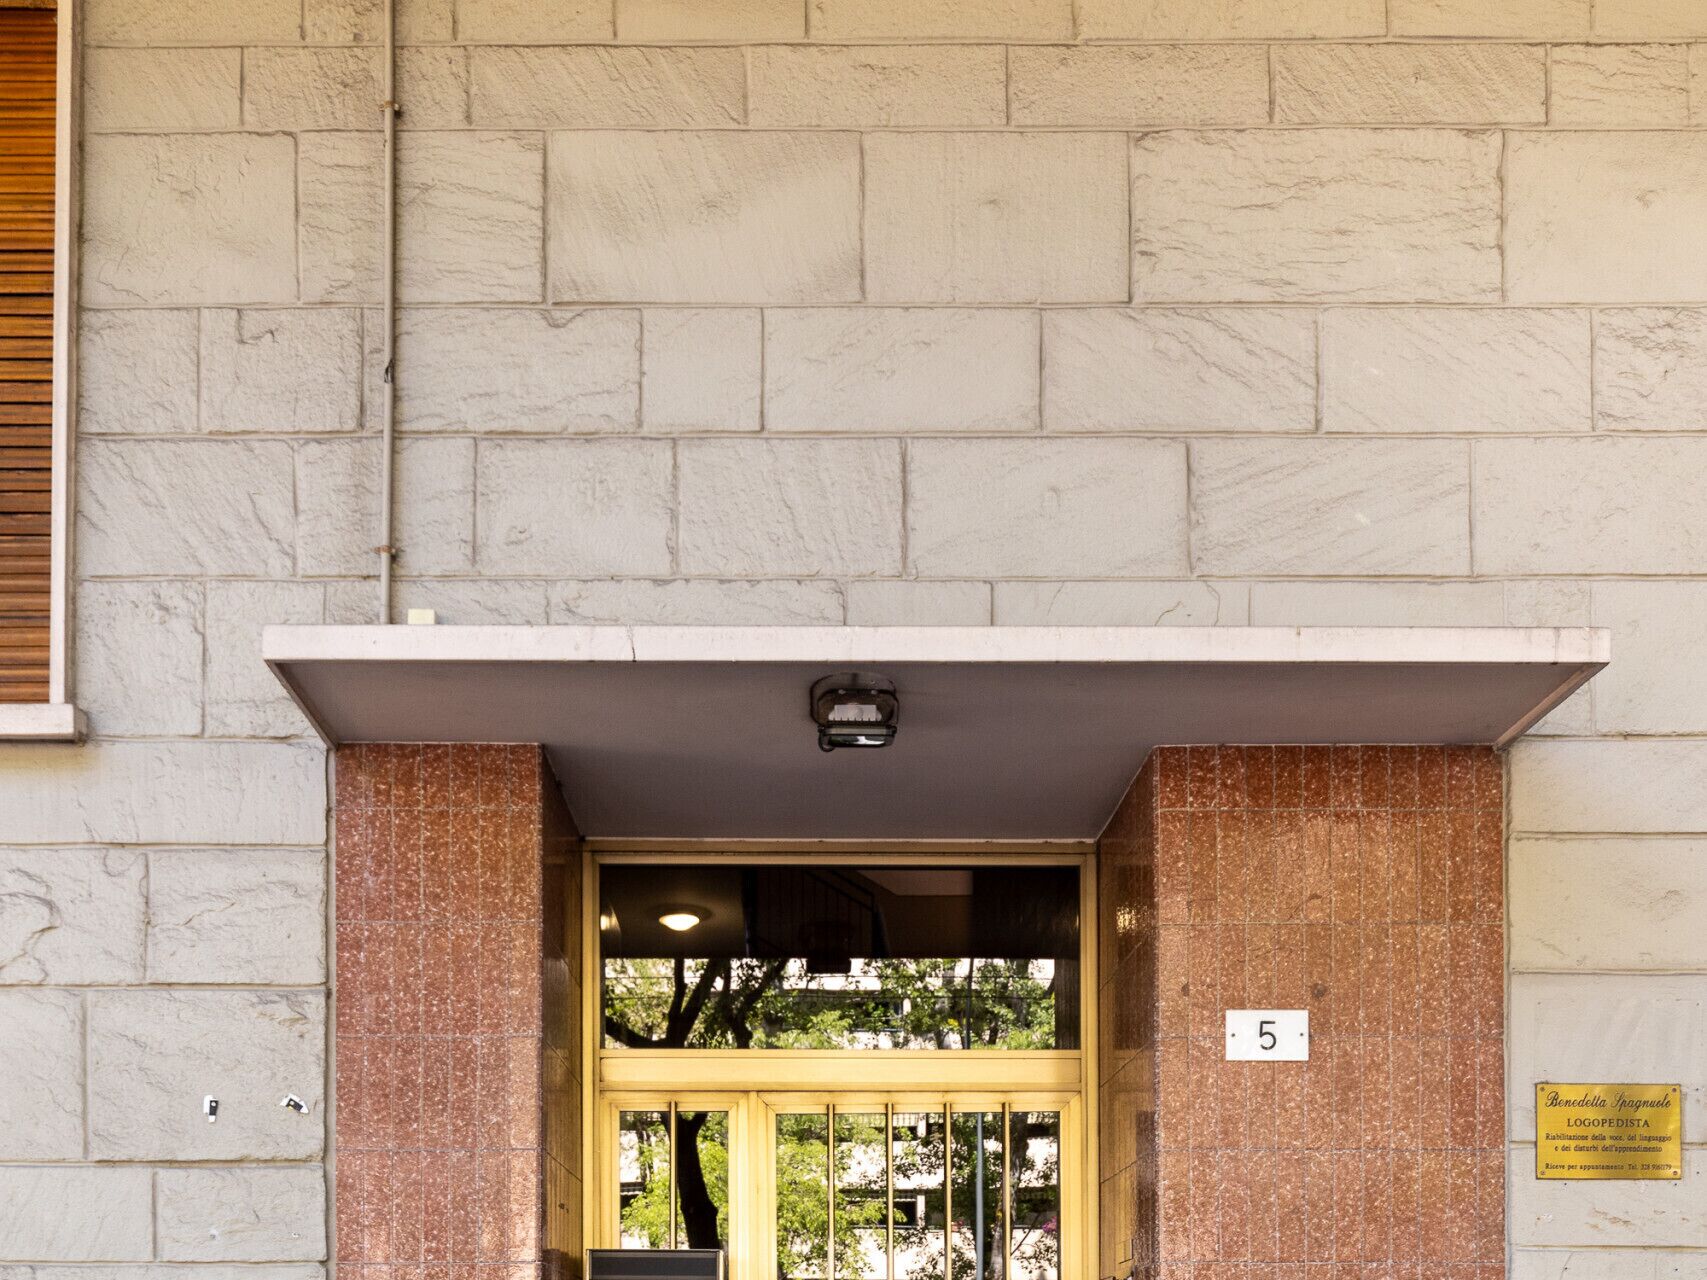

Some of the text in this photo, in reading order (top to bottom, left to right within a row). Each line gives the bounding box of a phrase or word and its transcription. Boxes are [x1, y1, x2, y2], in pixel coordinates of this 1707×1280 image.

[1259, 1020, 1277, 1051] 5
[1545, 1090, 1608, 1108] Benedetta
[1566, 1118, 1651, 1128] LOGOPEDISTA
[1545, 1132, 1589, 1142] Riabilitazione
[1591, 1132, 1607, 1142] della
[1627, 1132, 1637, 1142] del
[1639, 1132, 1673, 1144] linguaggio
[1561, 1144, 1571, 1152] dei
[1573, 1144, 1600, 1152] disturbi
[1601, 1144, 1663, 1153] dell'apprendimento
[1545, 1162, 1566, 1171] Riceve
[1567, 1163, 1578, 1172] per
